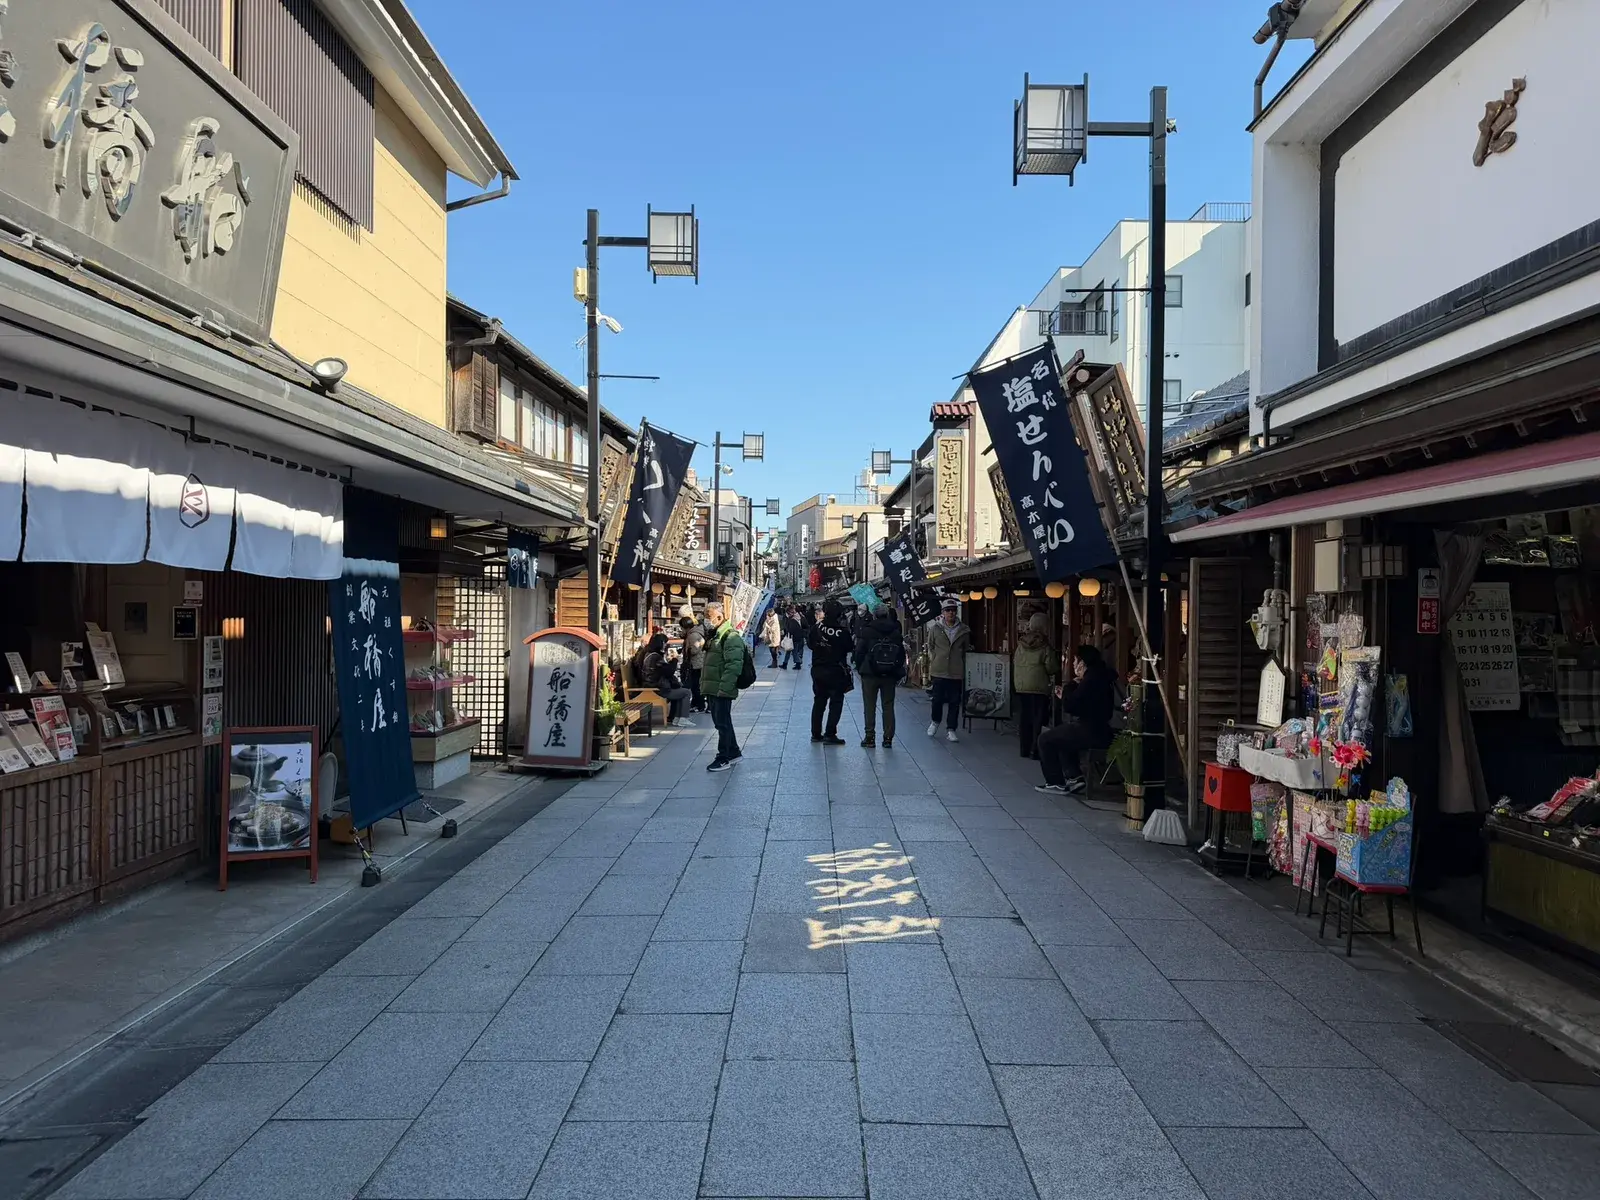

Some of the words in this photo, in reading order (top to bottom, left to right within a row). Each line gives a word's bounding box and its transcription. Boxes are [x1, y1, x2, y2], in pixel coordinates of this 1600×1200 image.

[1002, 375, 1075, 550] 塩せんべい
[889, 548, 931, 616] 草だんご
[1421, 600, 1431, 630] 作動中
[1456, 613, 1461, 621] 2
[1468, 613, 1473, 621] 3
[1478, 613, 1484, 621] 4
[1490, 613, 1495, 621] 5
[1501, 613, 1507, 621] 6
[1467, 629, 1476, 637] 10
[1478, 629, 1487, 637] 11
[1490, 629, 1499, 637] 12
[1501, 629, 1510, 637] 13
[358, 580, 387, 733] 船橋屋
[1458, 645, 1466, 654] 16
[1469, 645, 1477, 654] 17
[1480, 645, 1489, 654] 18
[1491, 645, 1500, 654] 19
[1502, 645, 1512, 654] 20
[1458, 662, 1468, 670] 23
[1469, 662, 1479, 670] 24
[1480, 662, 1490, 670] 25
[1492, 662, 1502, 670] 26
[1504, 662, 1513, 670] 27
[1471, 679, 1480, 687] 31
[543, 666, 575, 748] 船橋屋
